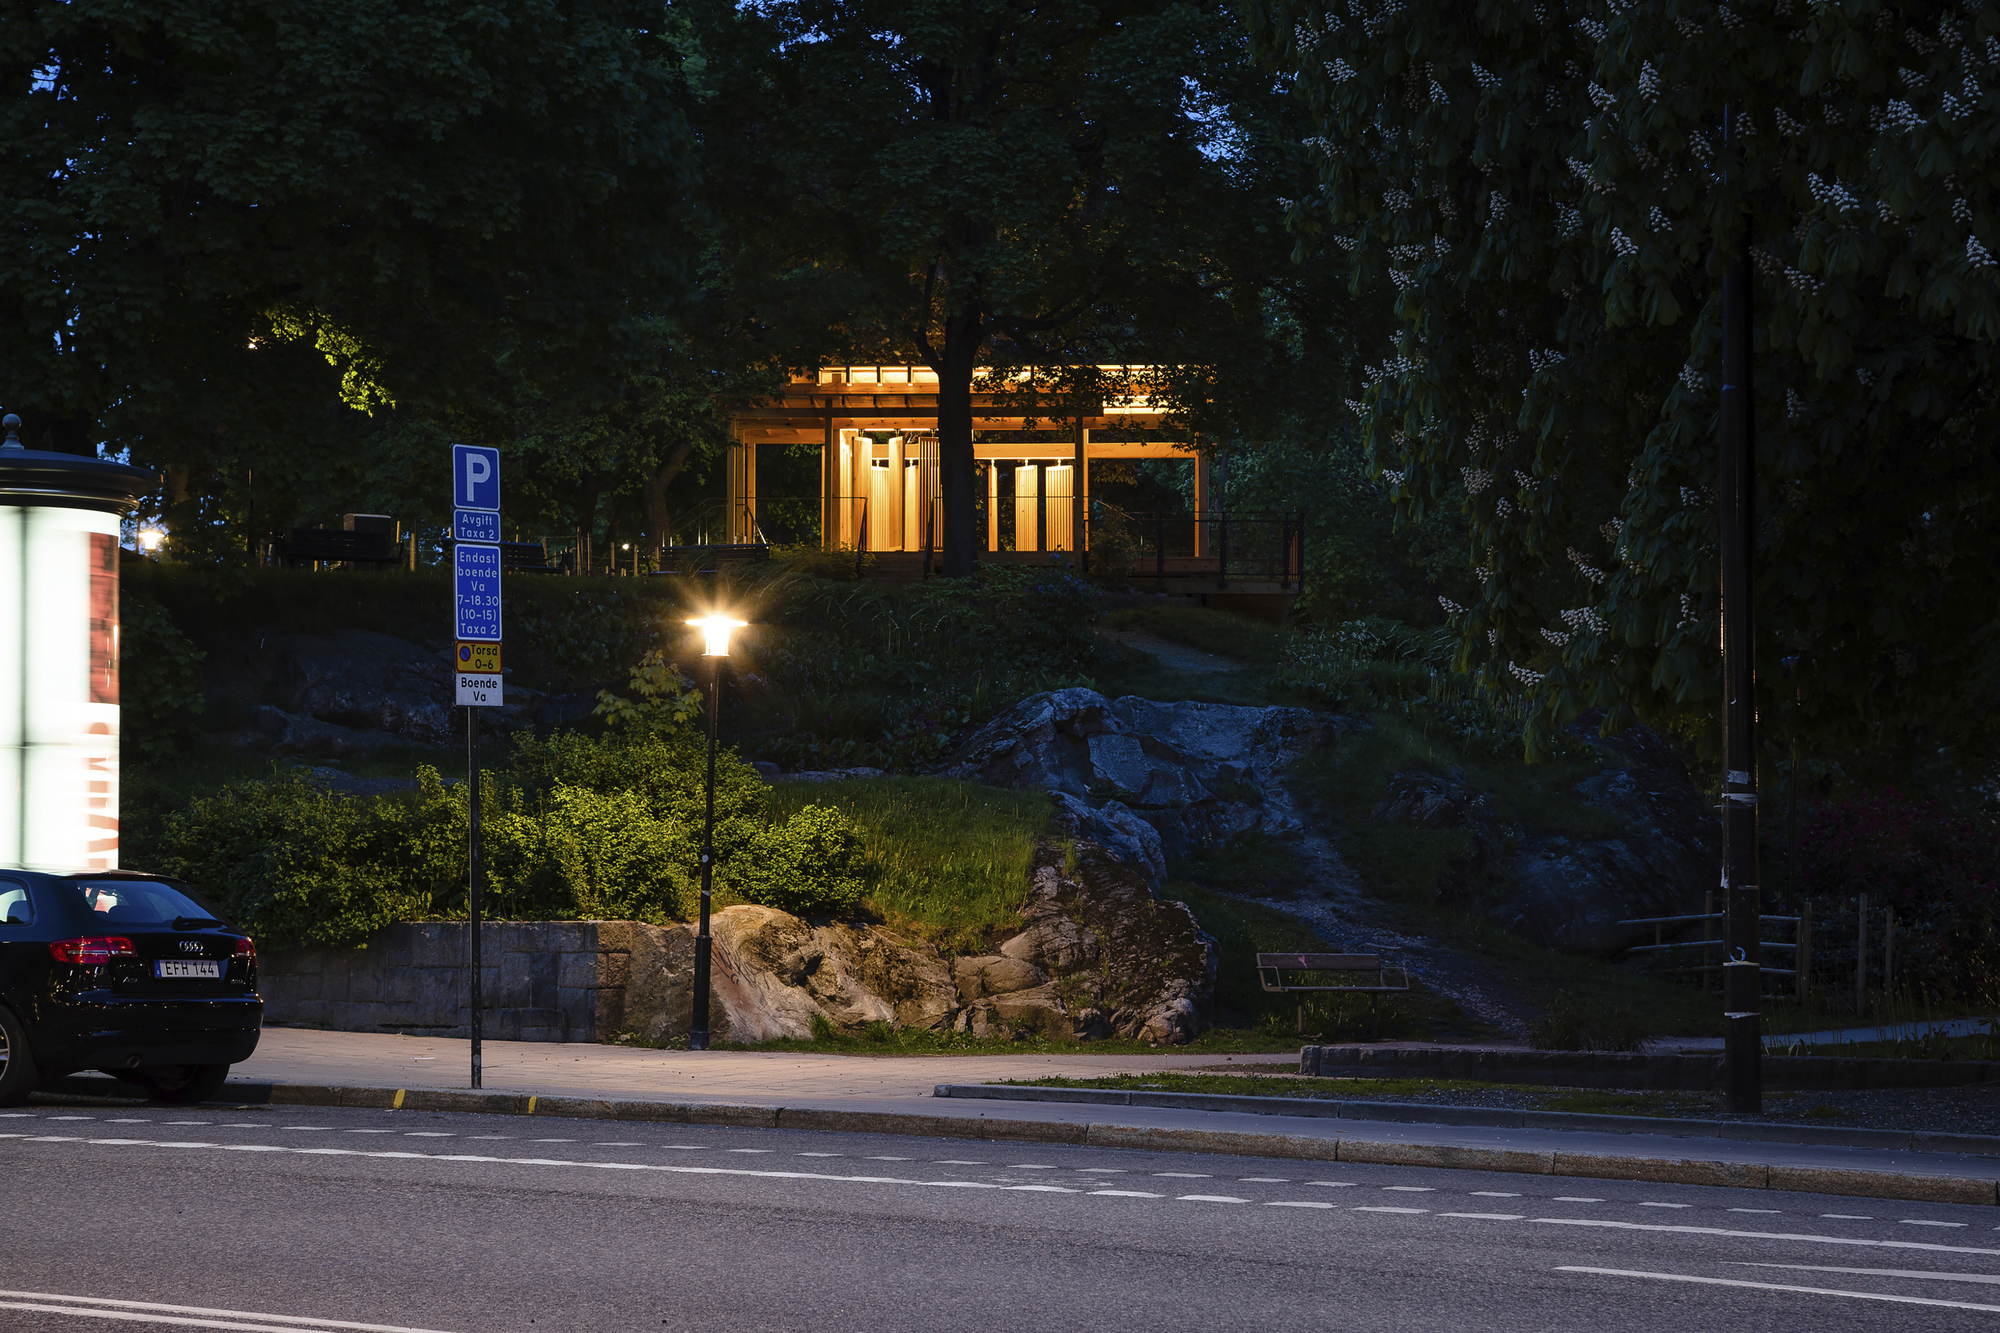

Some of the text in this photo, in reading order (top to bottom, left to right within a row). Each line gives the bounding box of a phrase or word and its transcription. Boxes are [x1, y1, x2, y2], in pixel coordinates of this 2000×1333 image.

[466, 453, 491, 502] P
[462, 514, 492, 527] Avgift
[461, 527, 494, 539] Taxa 2
[460, 552, 495, 563] Endast
[458, 566, 497, 578] boende
[471, 581, 485, 592] Va
[458, 595, 498, 606] 7-18.30
[461, 609, 497, 621] (10-15)
[461, 623, 497, 635] Taxa 2
[471, 645, 498, 655] Torsd
[475, 659, 493, 669] 0-6
[461, 677, 498, 689] Boende
[473, 691, 486, 702] Va
[166, 961, 214, 975] EFH 144
